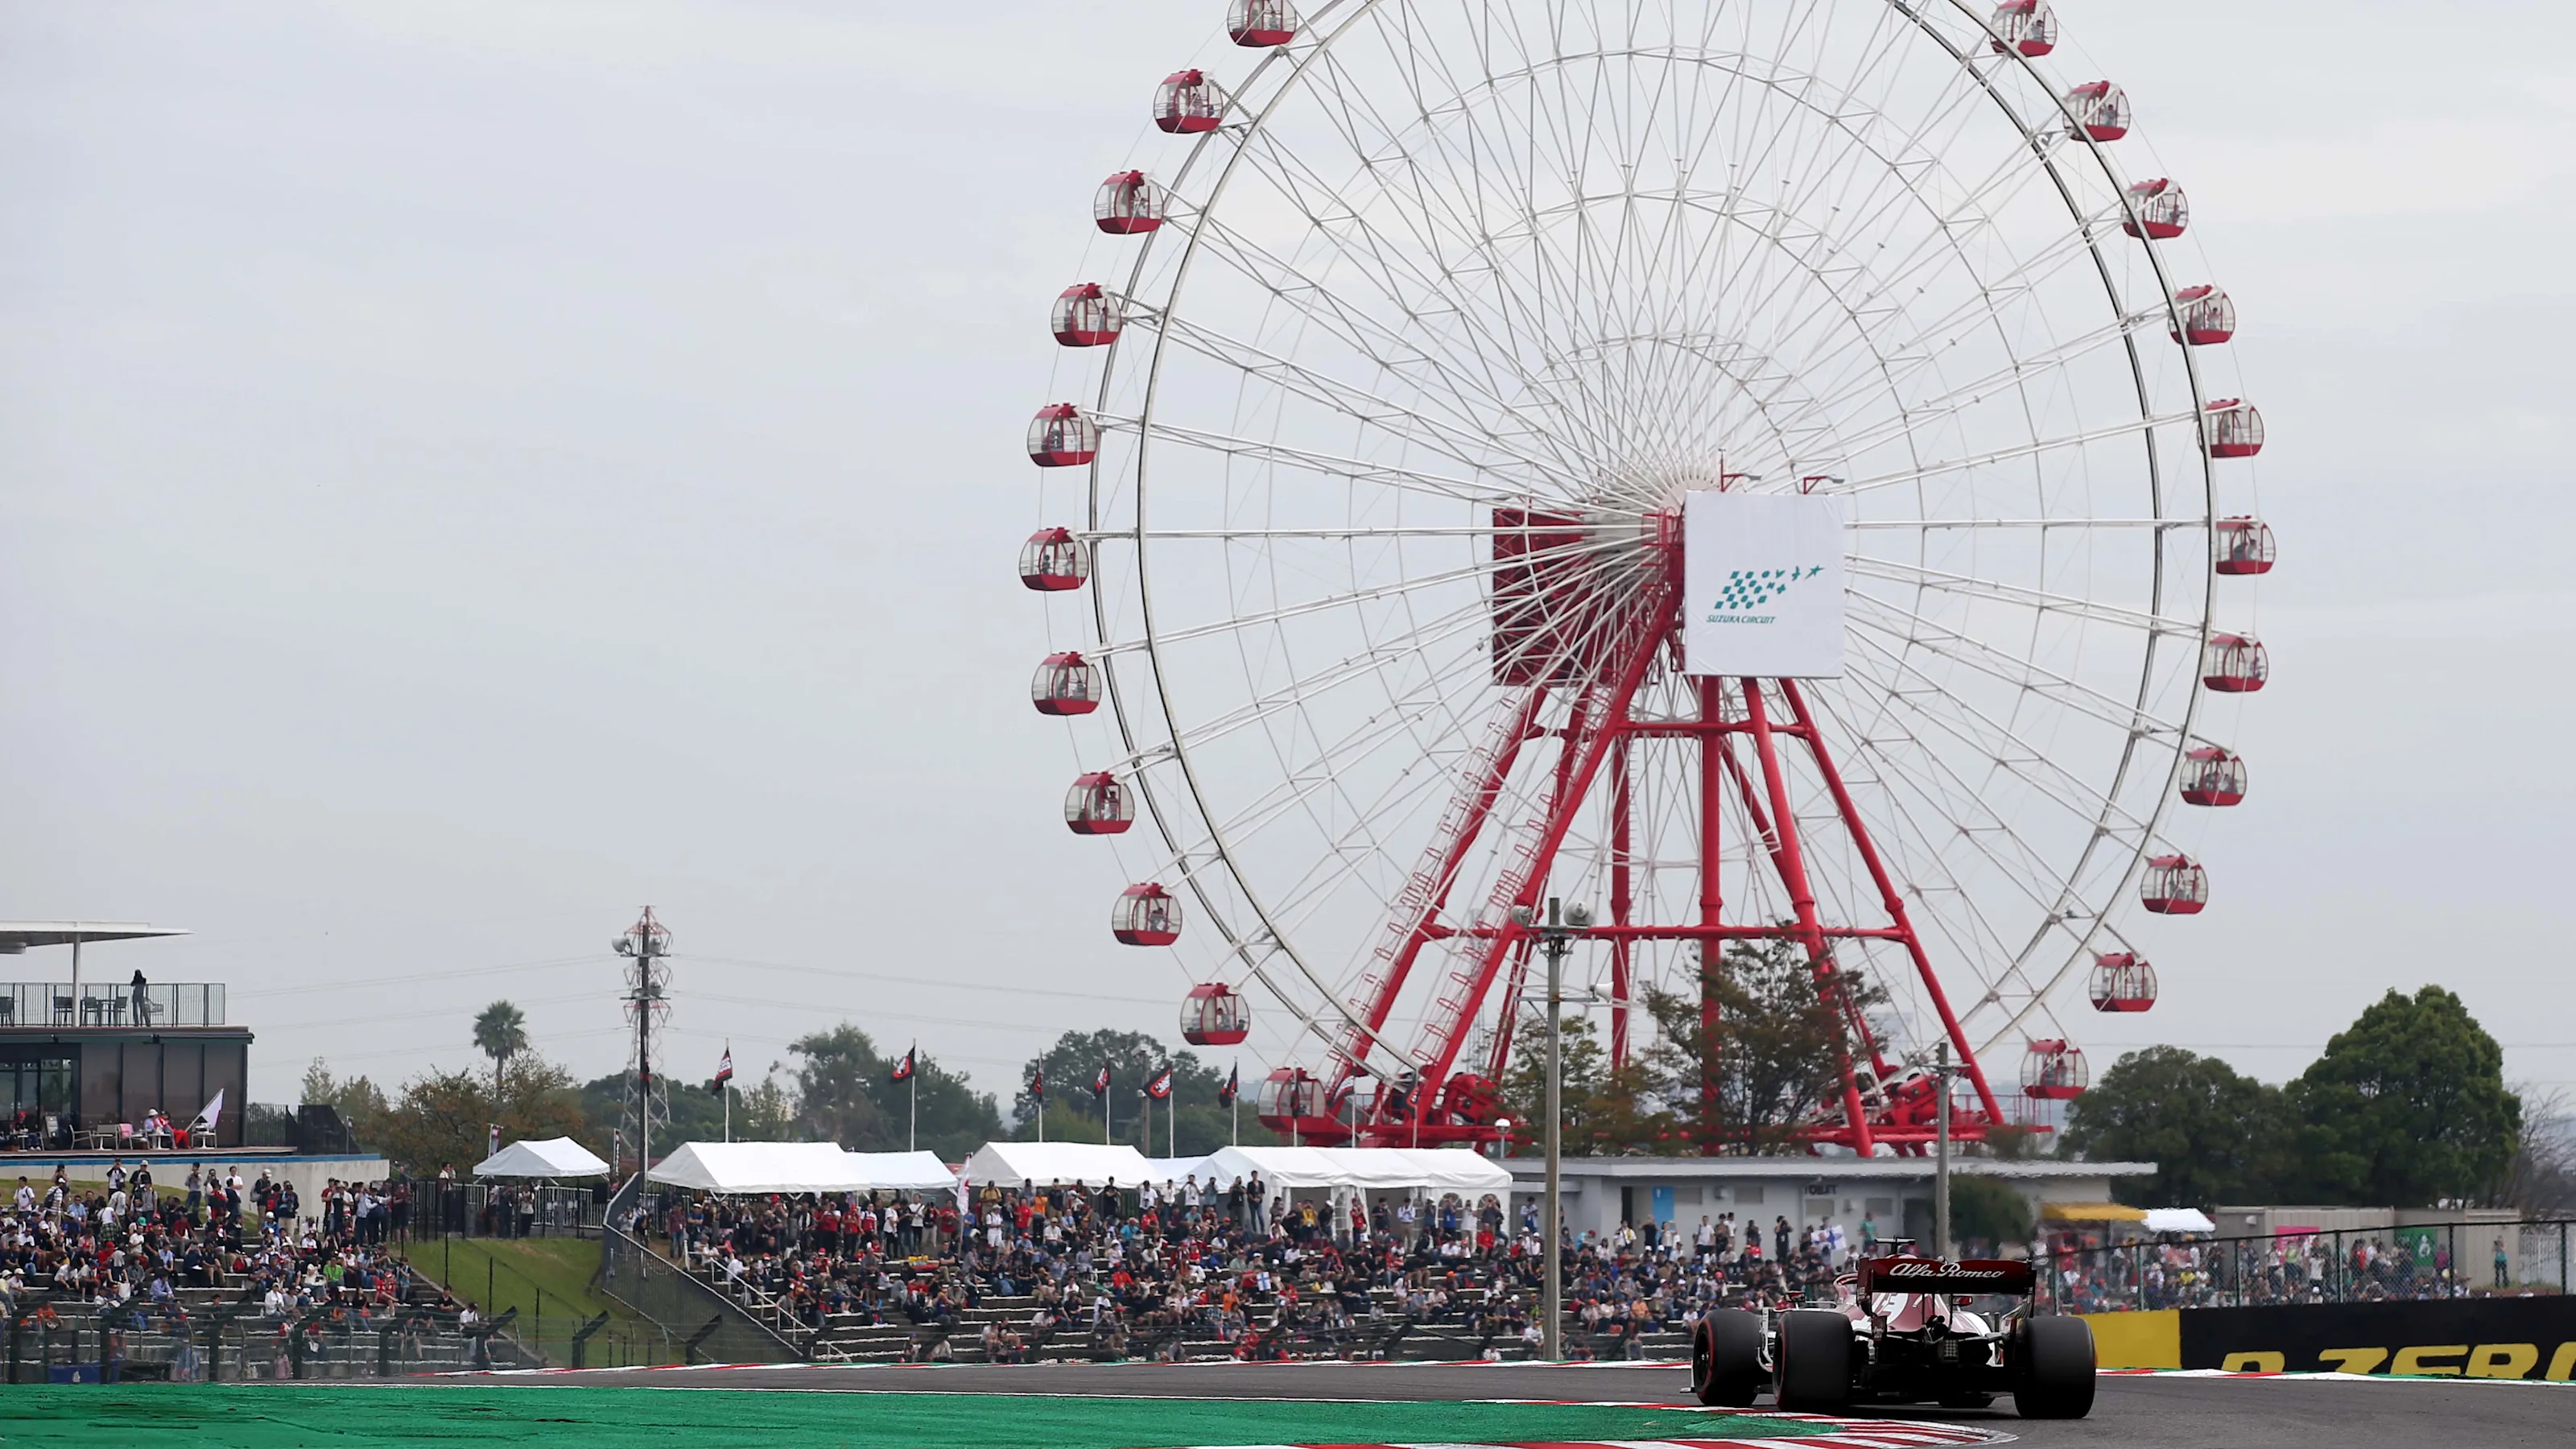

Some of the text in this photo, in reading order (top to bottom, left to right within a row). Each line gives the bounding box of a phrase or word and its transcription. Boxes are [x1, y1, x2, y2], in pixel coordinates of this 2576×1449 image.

[1706, 614, 1776, 624] SUZUKA CIRCUIT
[1889, 1263, 2005, 1278] Alfa Romeo
